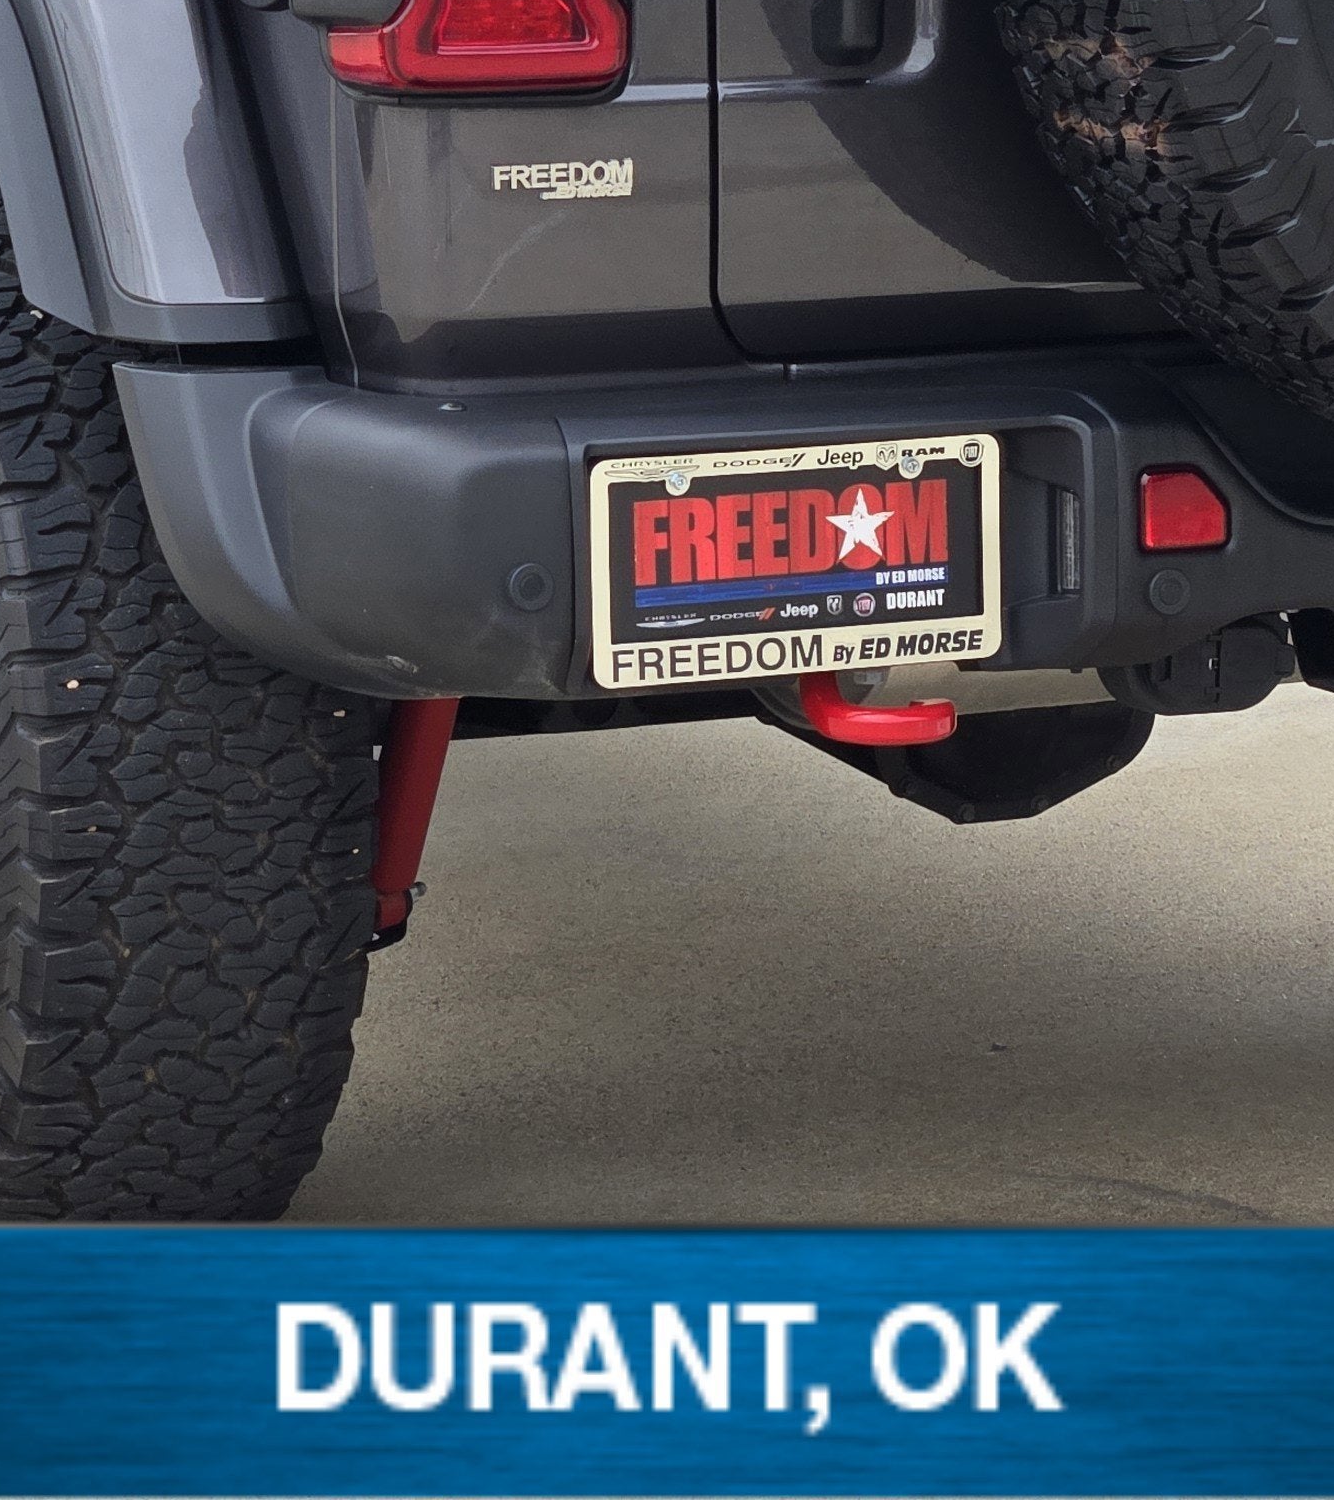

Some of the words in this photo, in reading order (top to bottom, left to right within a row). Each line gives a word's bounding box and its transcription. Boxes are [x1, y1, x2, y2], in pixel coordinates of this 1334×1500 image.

[491, 158, 634, 191] FREEDOM
[610, 457, 695, 469] CHRYSLER
[712, 455, 793, 469] DODGE
[816, 448, 865, 469] Jeep
[901, 446, 946, 458] RAM
[876, 571, 891, 586] BY
[892, 569, 906, 584] ED
[907, 566, 946, 583] MORSE
[779, 602, 819, 619] Jeep
[886, 588, 946, 611] DURANT
[611, 634, 824, 683] FREEDOM
[833, 643, 855, 665] By
[858, 635, 892, 661] ED
[894, 628, 985, 659] MORSE
